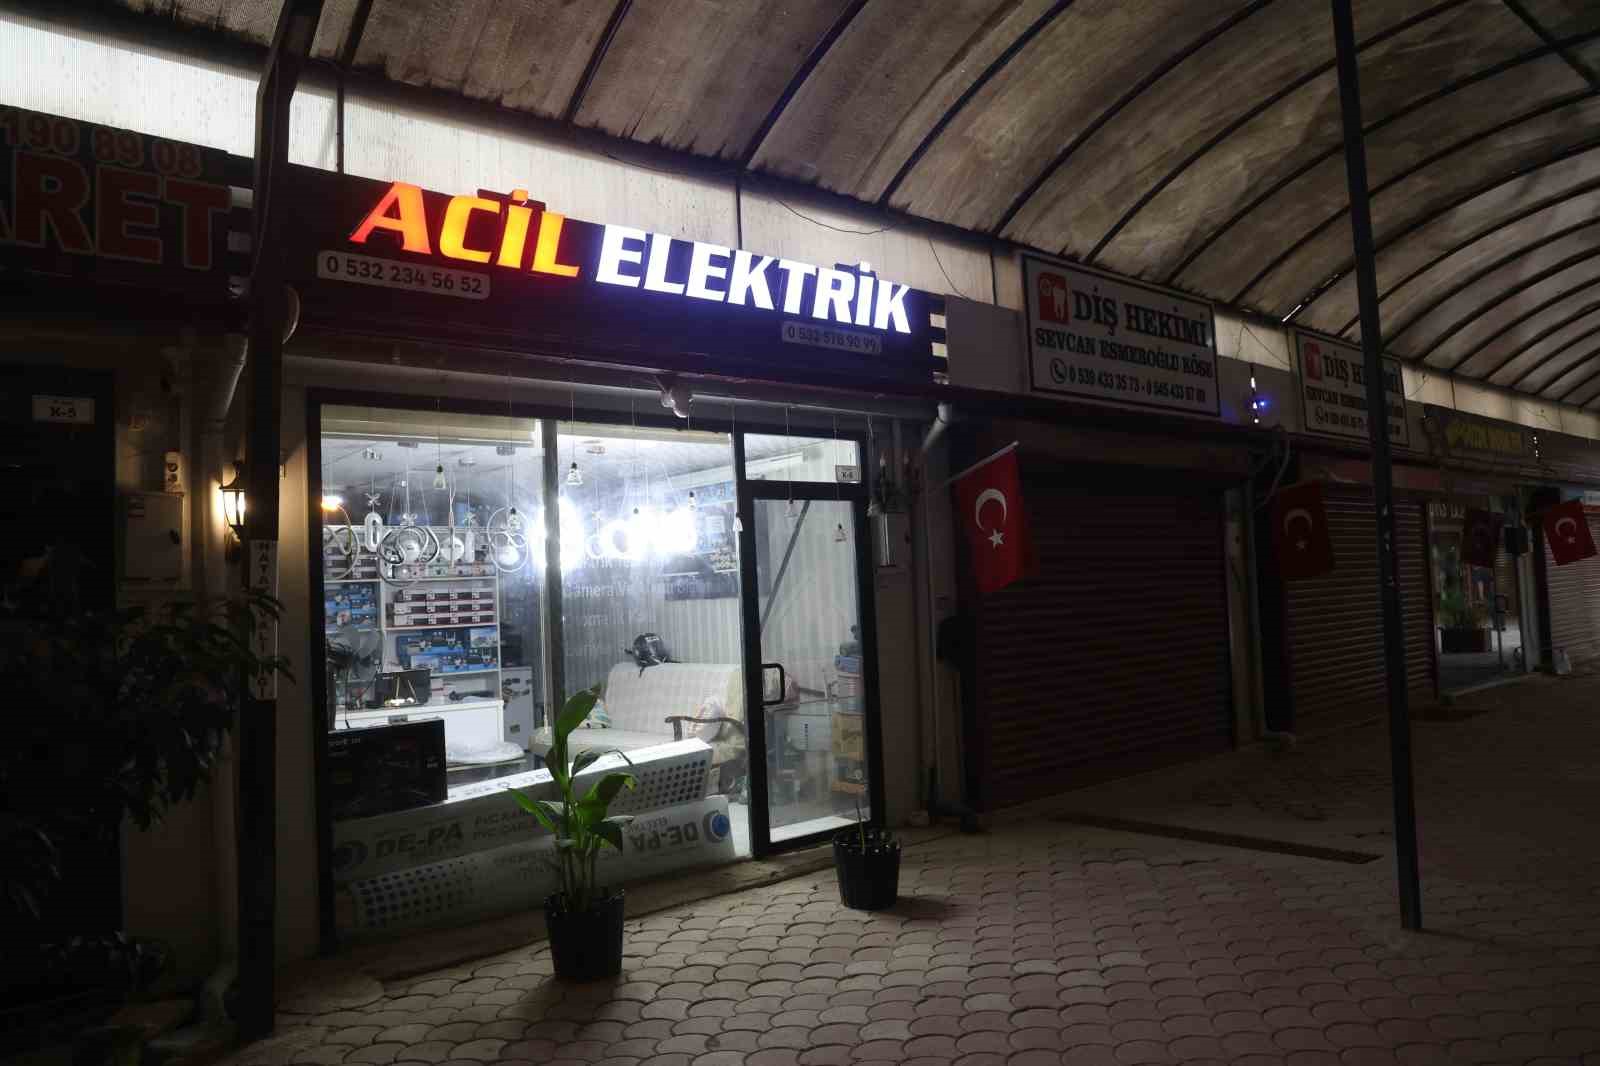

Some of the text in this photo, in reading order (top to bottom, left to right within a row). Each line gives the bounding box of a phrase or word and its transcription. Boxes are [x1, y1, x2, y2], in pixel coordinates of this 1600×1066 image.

[90, 126, 145, 168] 89
[151, 140, 204, 178] 08
[0, 147, 230, 271] RET
[326, 256, 481, 294] 0 532 234 56 52
[347, 181, 912, 334] ACİL ELEKTRİK
[788, 326, 796, 339] 0
[1035, 327, 1096, 357] SEVCAN
[1072, 285, 1209, 348] DİŞ HEKİMİ
